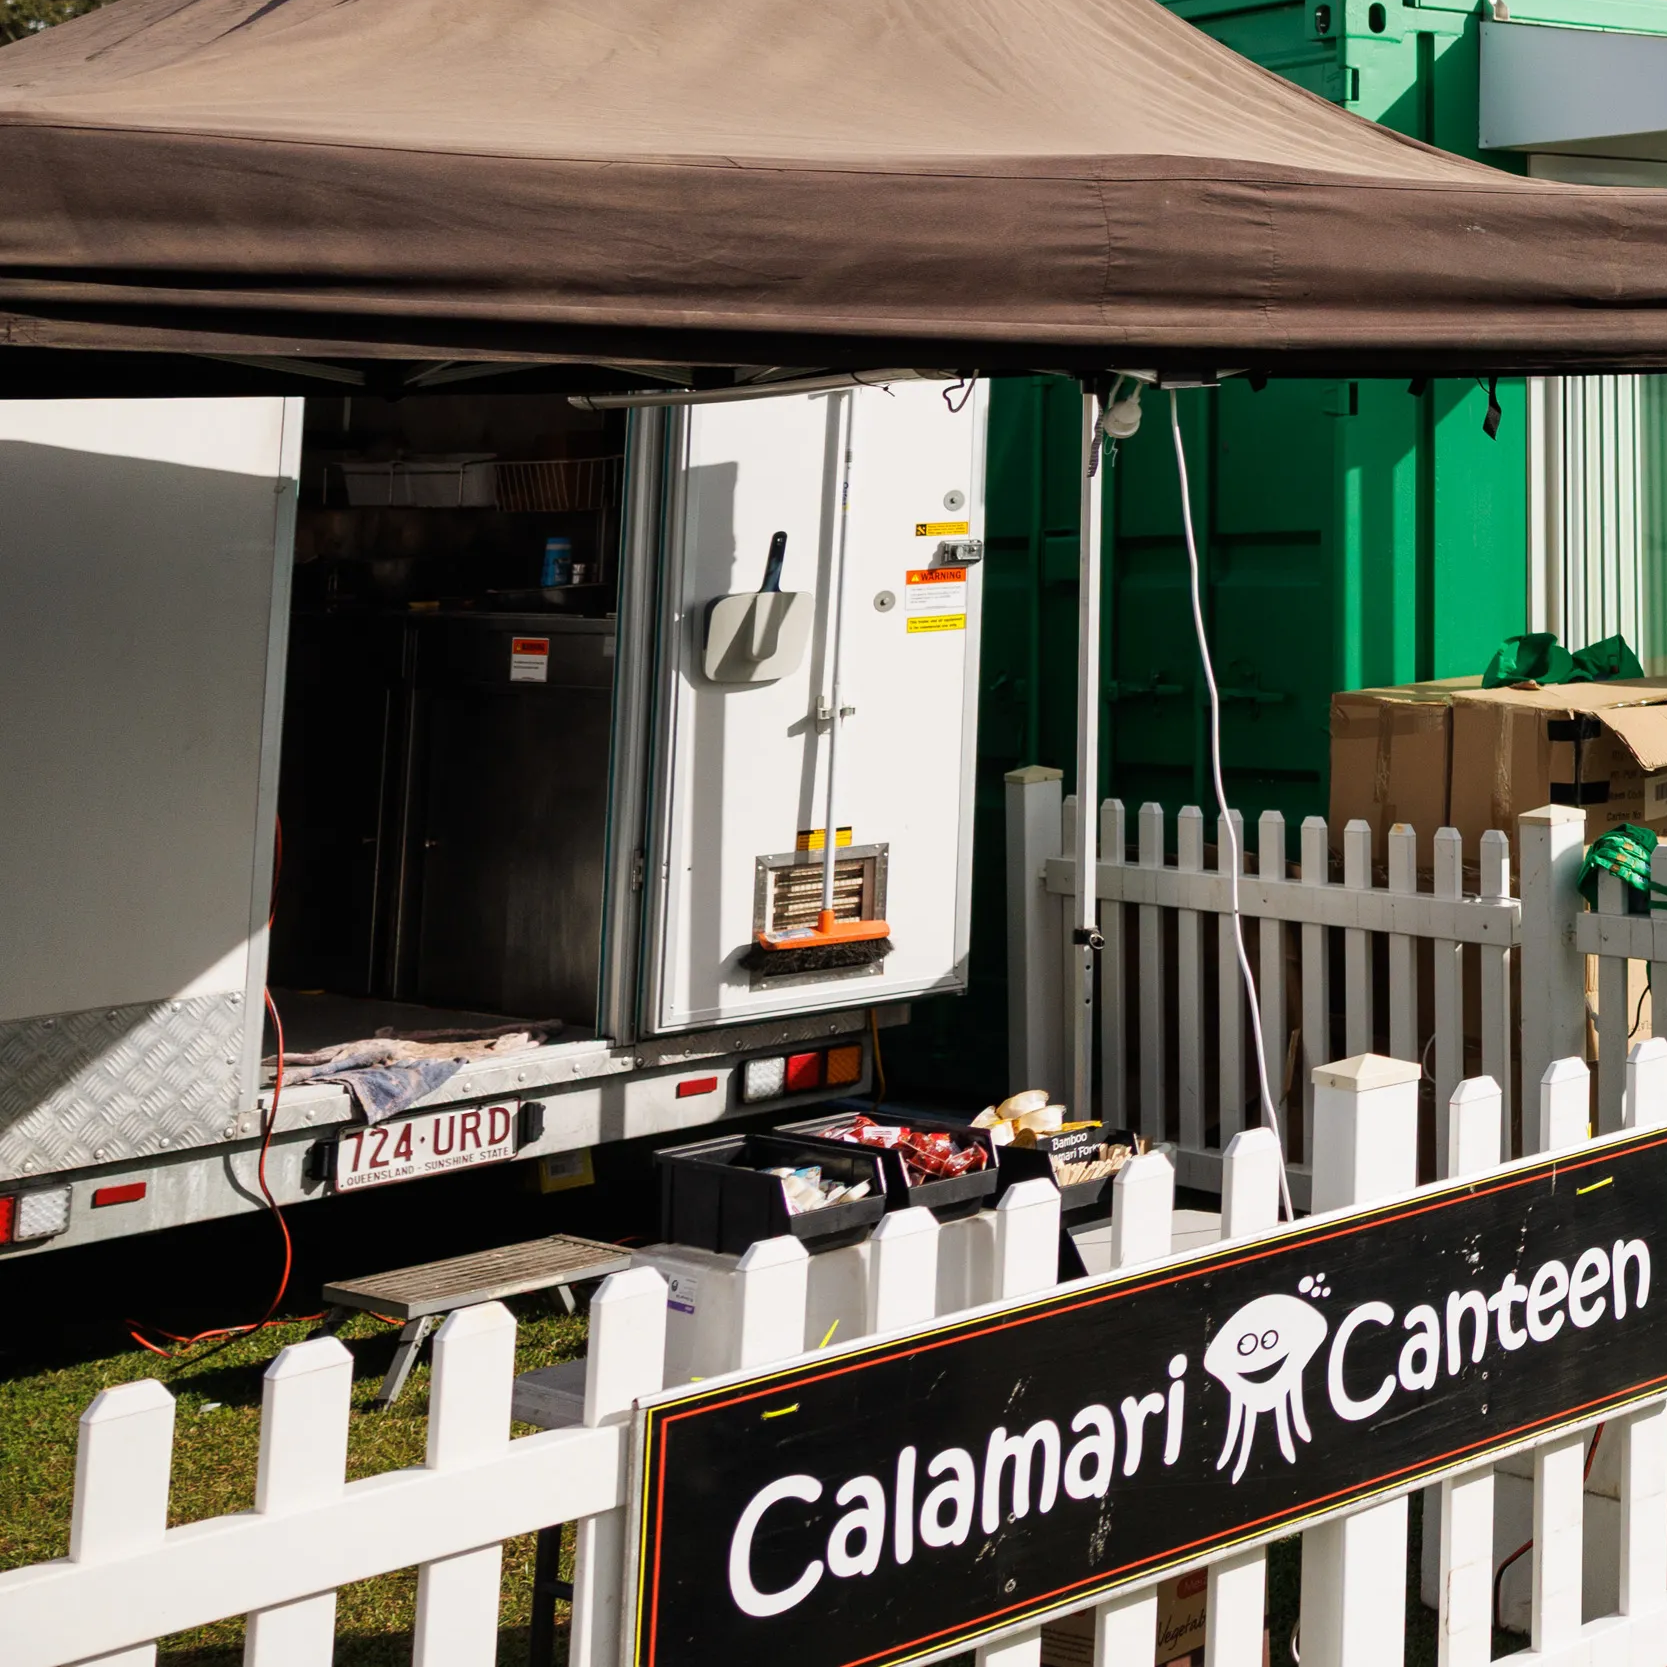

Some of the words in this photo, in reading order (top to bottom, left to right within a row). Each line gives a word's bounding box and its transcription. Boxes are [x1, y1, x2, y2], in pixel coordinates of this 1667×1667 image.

[920, 570, 962, 581] WARNING
[1051, 1132, 1088, 1151] Bamboo
[346, 1166, 415, 1187] QUEENSLAND
[424, 1153, 475, 1172] SUNSHINE
[479, 1146, 510, 1161] STATE
[727, 1354, 1188, 1618] Calamari
[1327, 1237, 1652, 1422] Canteen
[1157, 1608, 1207, 1651] Vegetab
